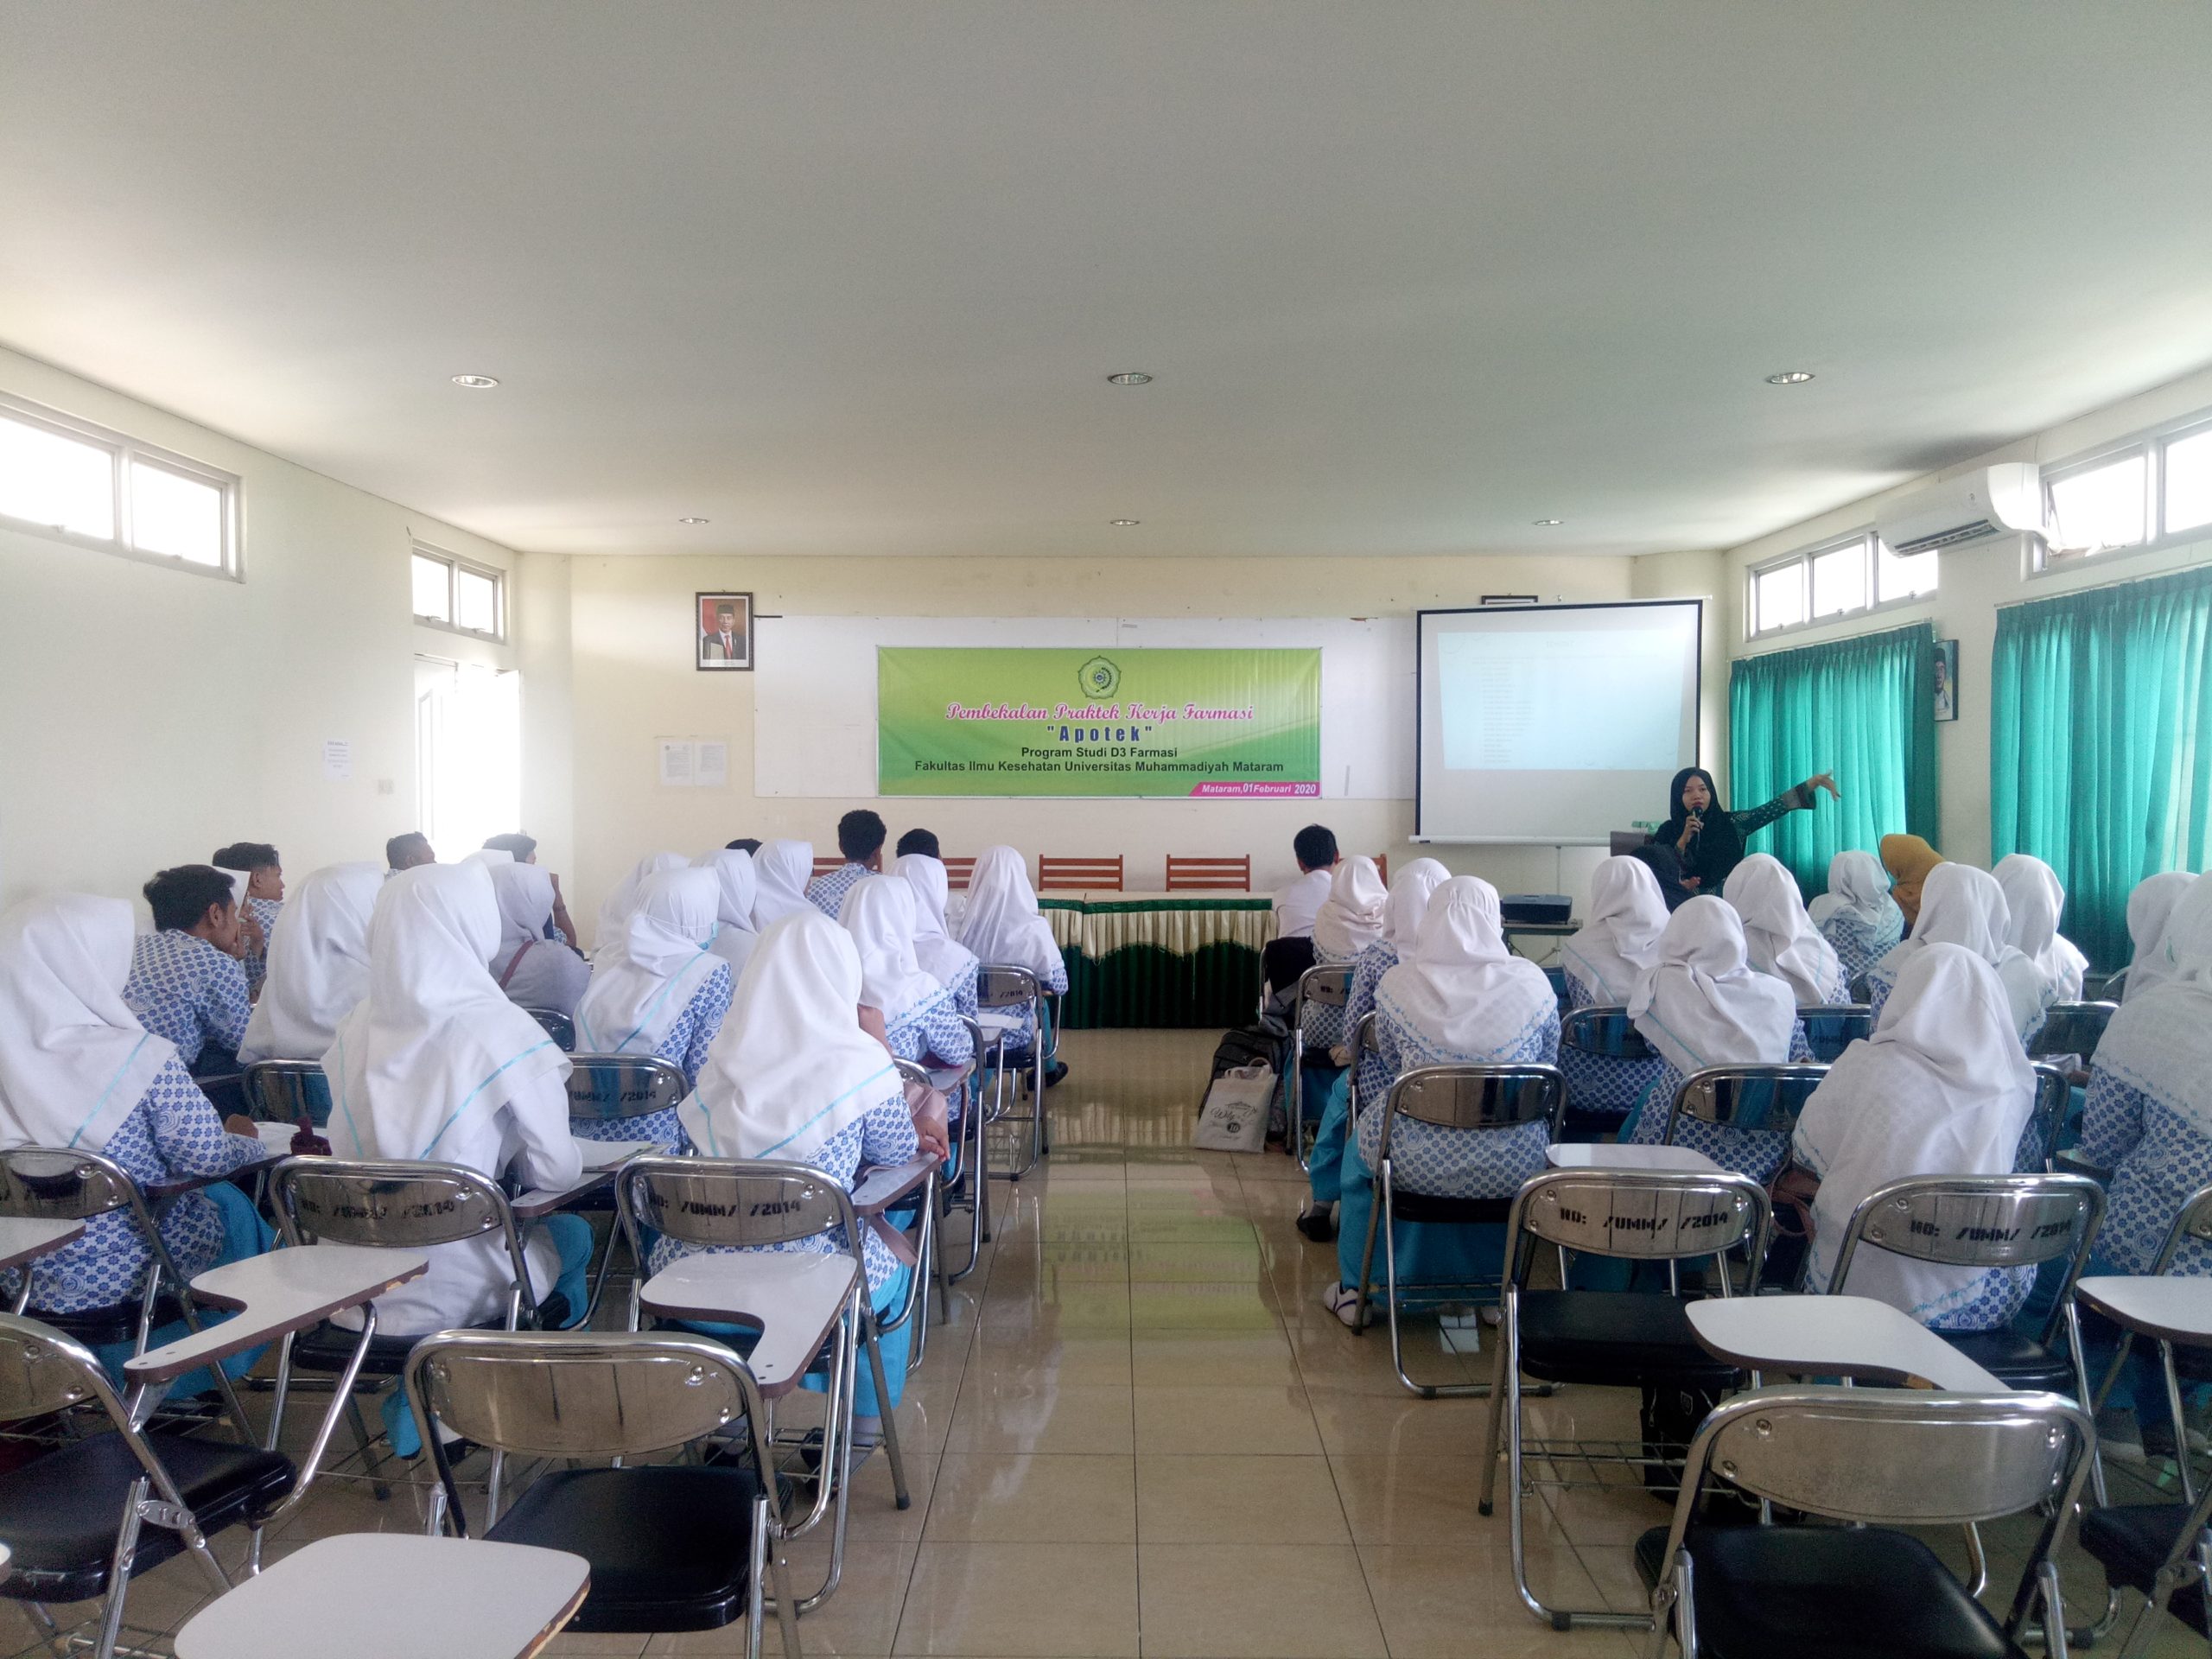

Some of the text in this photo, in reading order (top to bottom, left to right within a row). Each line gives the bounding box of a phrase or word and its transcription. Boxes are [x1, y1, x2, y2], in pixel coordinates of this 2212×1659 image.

[945, 702, 1254, 724] Pembekalan Praktek Kerja Farmasi
[1021, 747, 1178, 760] Program Studi D3 Farmasi
[915, 761, 1284, 773] Fakultas Ilmu Kesehatan Universitas Muhammadiyah Mataram
[1294, 784, 1316, 794] 2020
